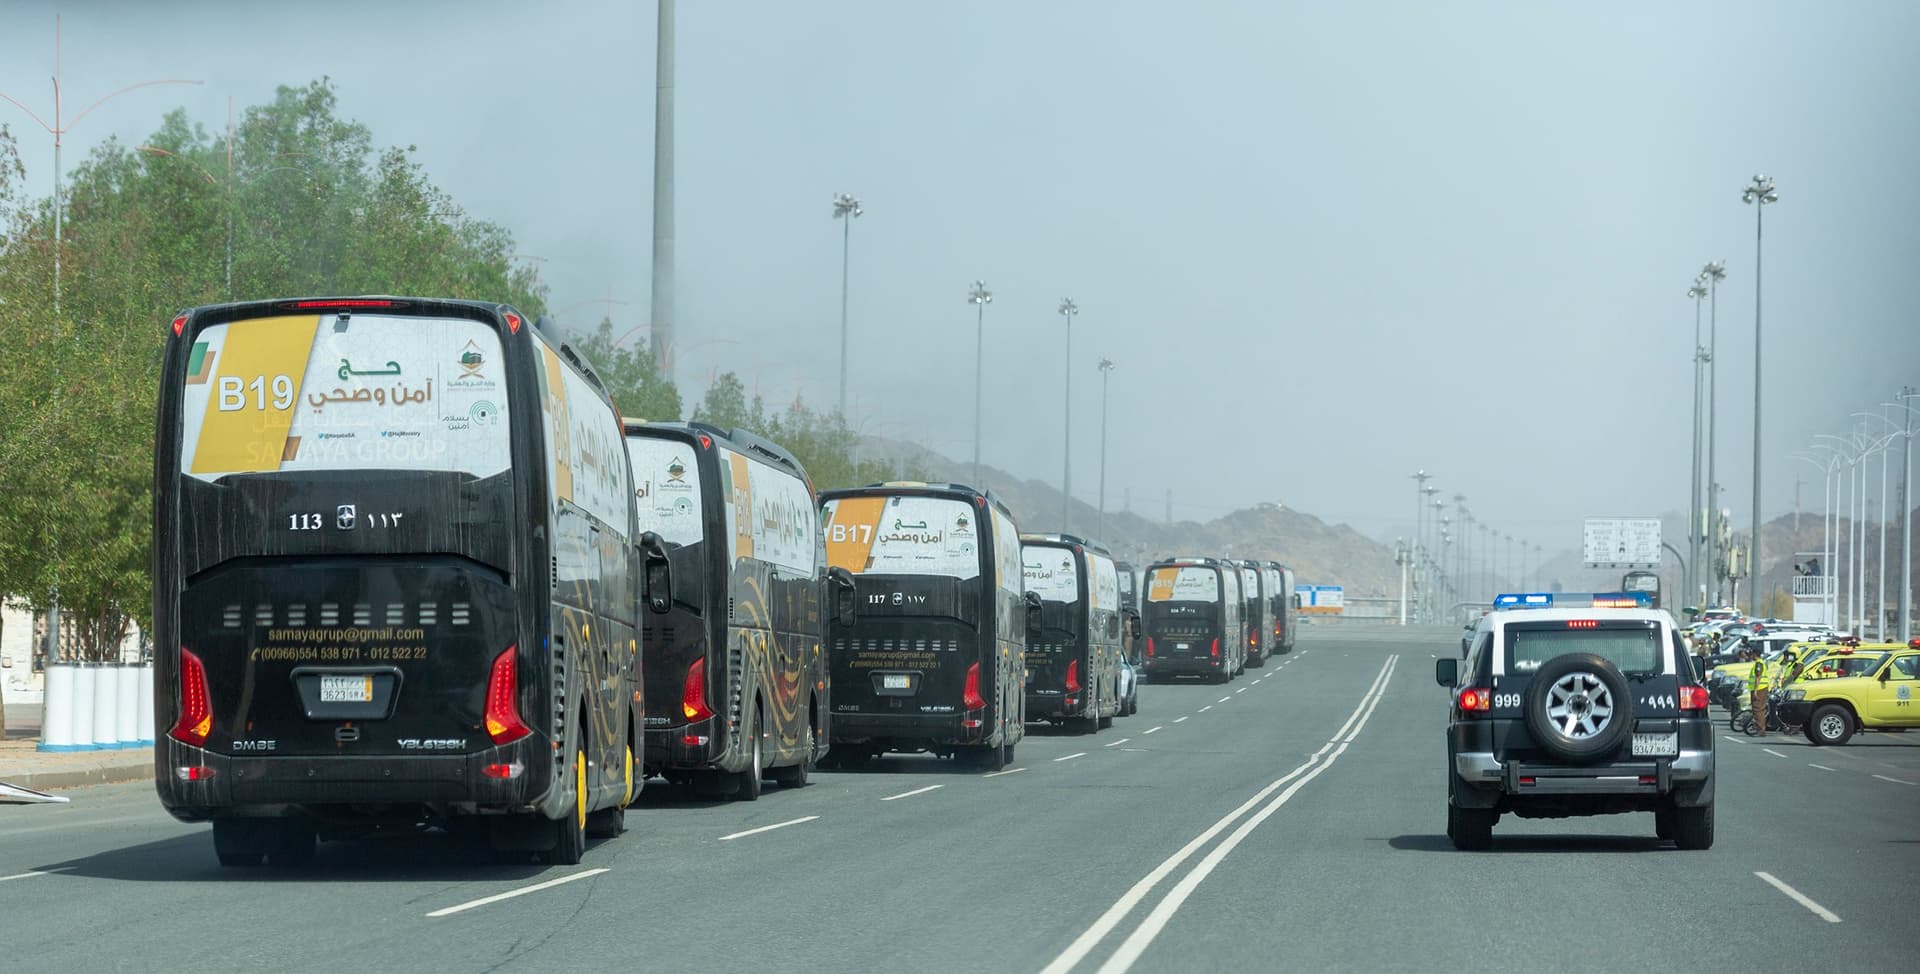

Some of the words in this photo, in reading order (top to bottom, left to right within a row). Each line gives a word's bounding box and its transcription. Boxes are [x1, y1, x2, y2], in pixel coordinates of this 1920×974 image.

[338, 358, 401, 380] حج
[218, 374, 295, 412] B19
[391, 377, 432, 406] آمن
[308, 388, 386, 414] وصحي
[289, 513, 322, 530] 113
[368, 513, 403, 528] ١١٣
[894, 518, 927, 530] حج
[832, 524, 872, 544] B17
[879, 532, 919, 547] وصحي
[869, 595, 886, 604] 117
[268, 627, 424, 643] samayagrup@gmail.com
[321, 647, 339, 660] 538
[342, 647, 360, 659] 971
[370, 647, 389, 659] 012
[392, 647, 411, 659] 522
[1494, 694, 1521, 708] 999
